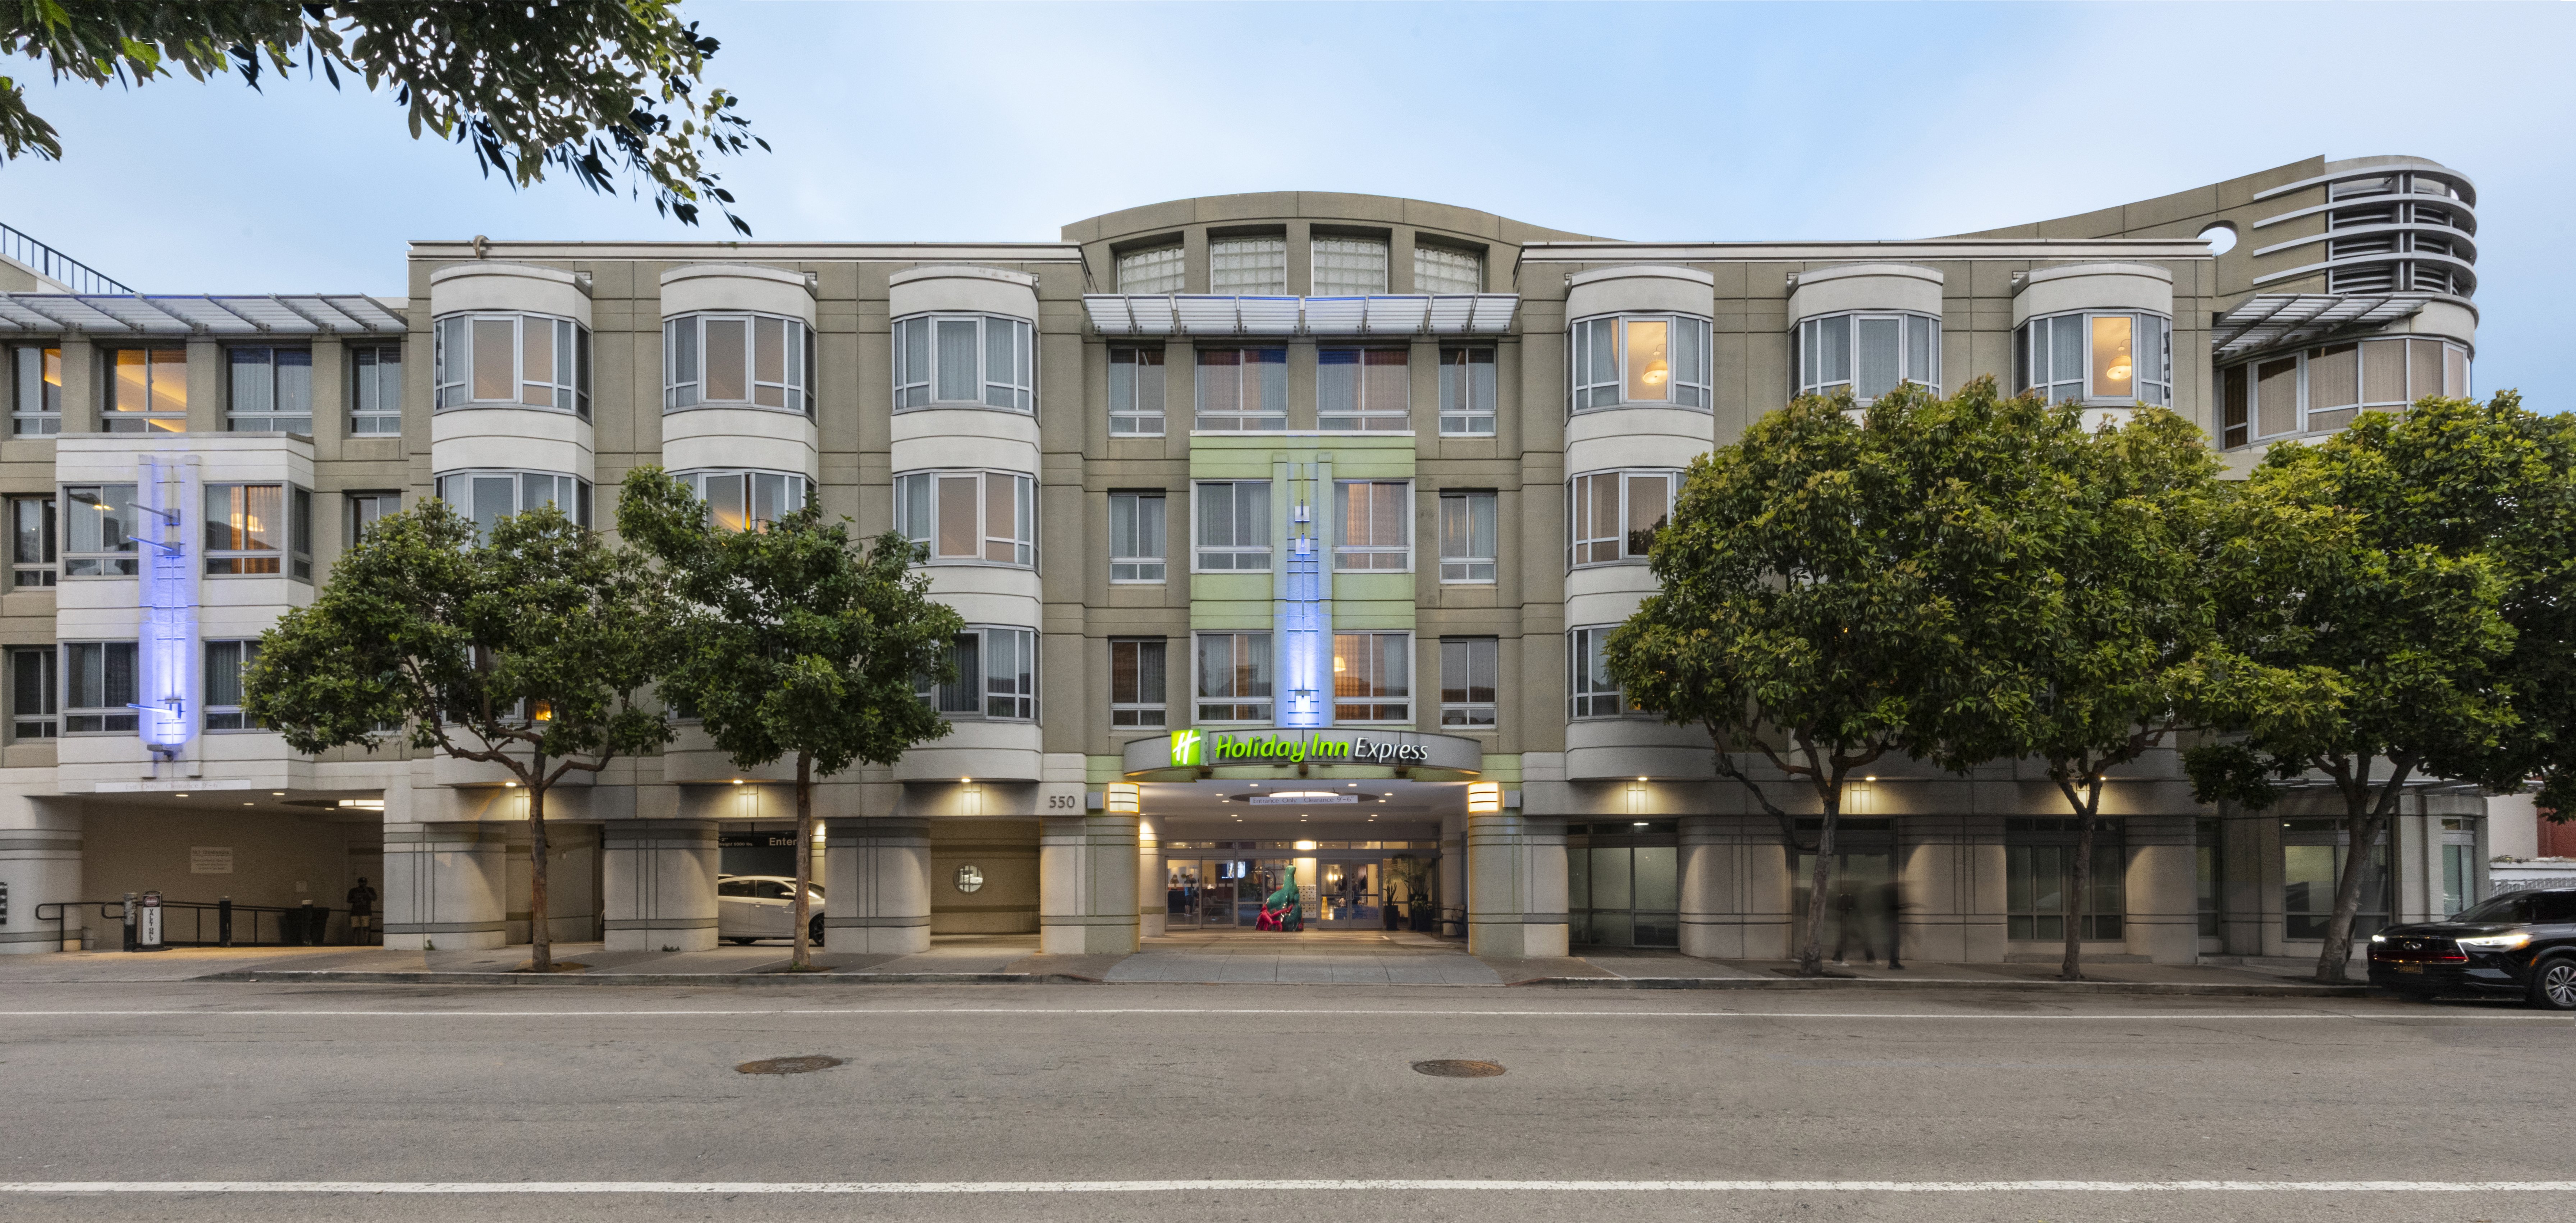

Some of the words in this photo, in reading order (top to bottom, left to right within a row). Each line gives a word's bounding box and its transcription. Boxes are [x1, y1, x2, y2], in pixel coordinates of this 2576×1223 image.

[1215, 734, 1307, 762] Holiday
[1312, 733, 1349, 757] Inn
[1354, 737, 1428, 763] Express
[1049, 795, 1075, 808] 550
[769, 837, 797, 846] Enter
